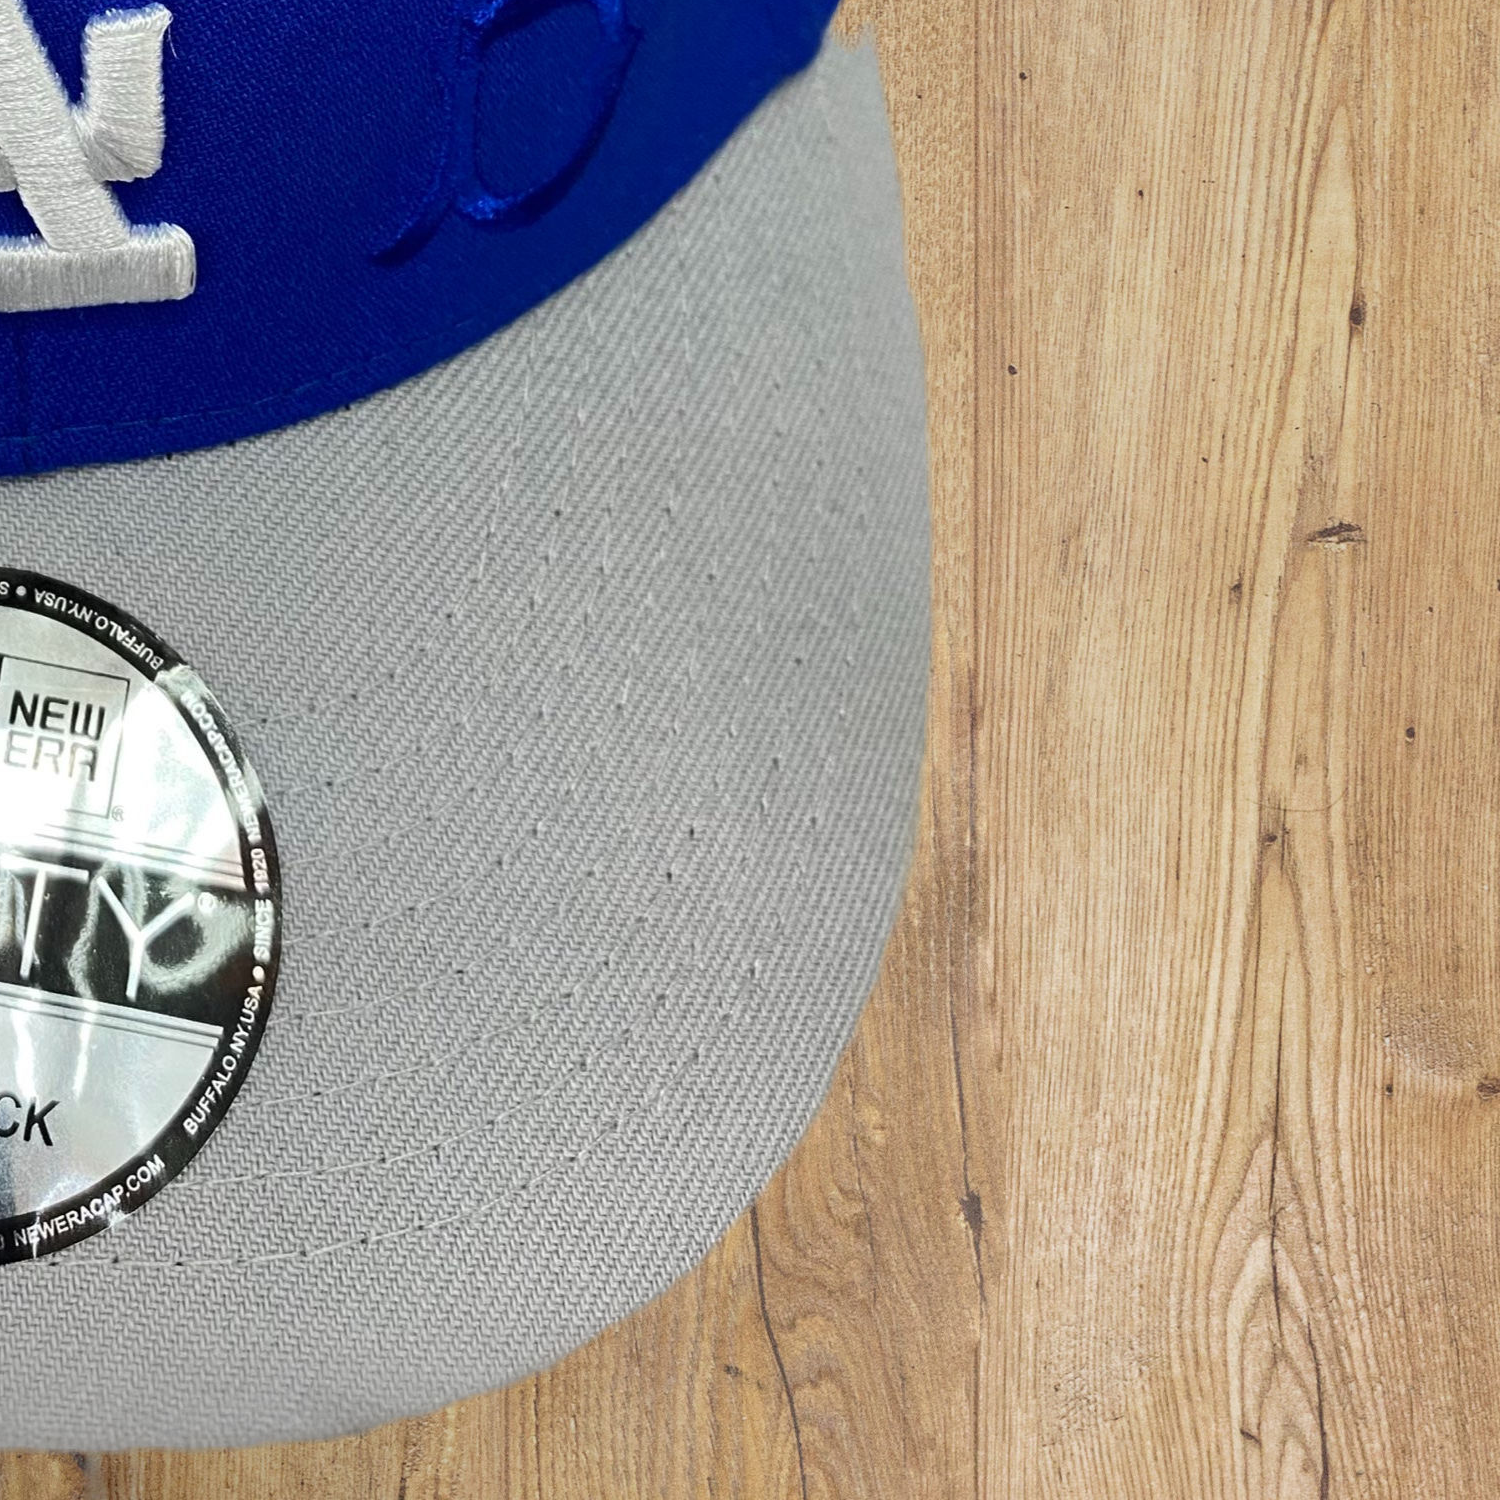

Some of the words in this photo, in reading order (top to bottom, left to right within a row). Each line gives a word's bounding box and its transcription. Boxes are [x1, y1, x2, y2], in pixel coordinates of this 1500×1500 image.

[33, 587, 165, 671] BUFFALO.NY.USA
[8, 689, 106, 742] NEW
[3, 729, 98, 782] ERA
[249, 847, 270, 894] 1920
[253, 898, 275, 963] SINCE
[182, 984, 264, 1136] BUFFALO.NY.USA
[12, 1153, 166, 1247] NEWERACAP.COM
